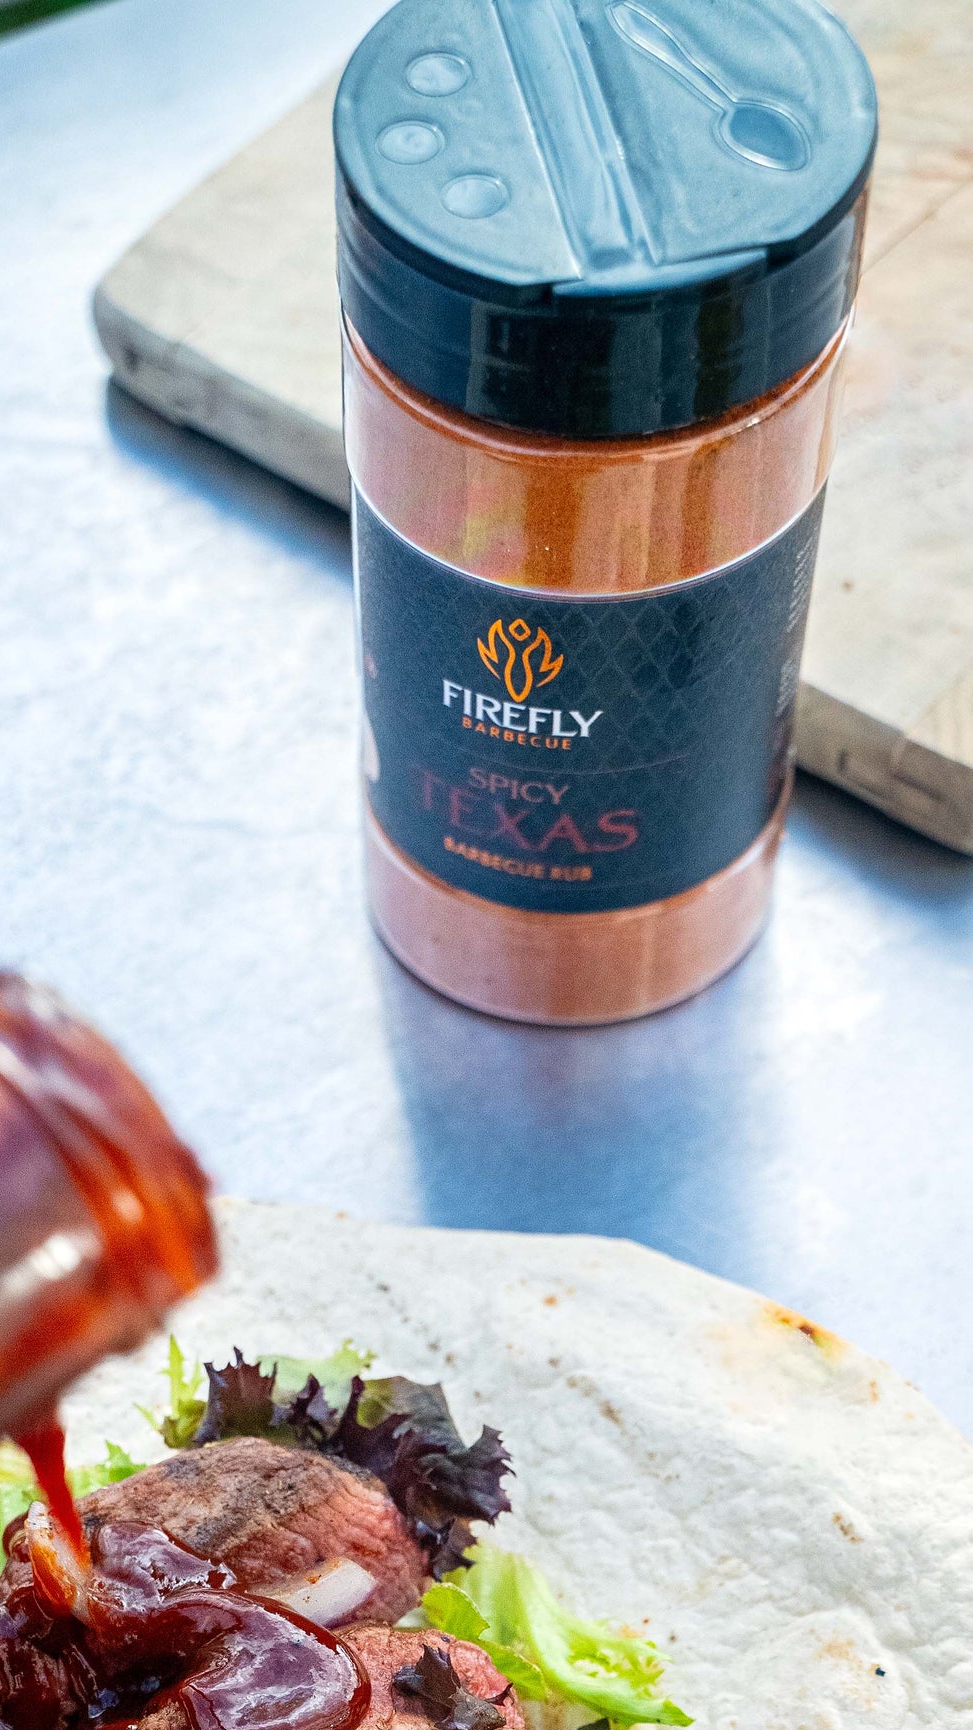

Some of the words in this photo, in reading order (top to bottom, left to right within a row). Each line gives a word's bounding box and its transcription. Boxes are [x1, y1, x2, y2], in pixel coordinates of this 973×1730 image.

[443, 680, 604, 738] FIREFLY
[462, 716, 572, 750] BARBECUE
[469, 767, 570, 804] SPICY
[409, 766, 639, 853] TEXAS
